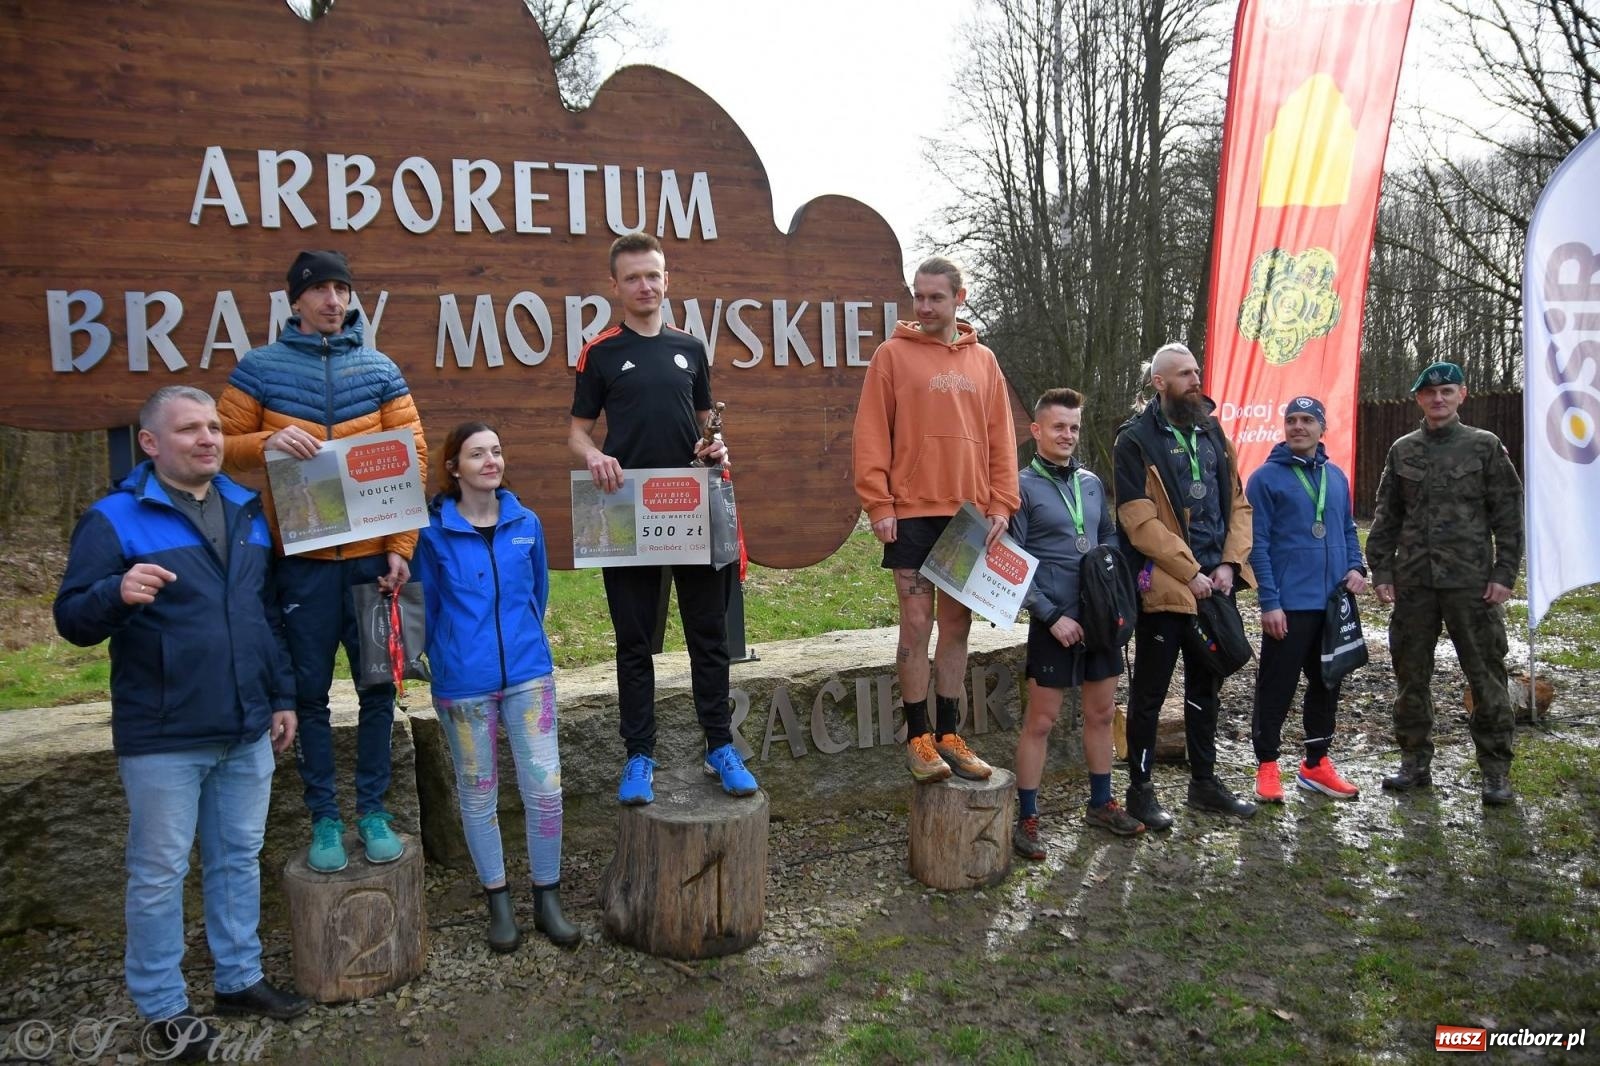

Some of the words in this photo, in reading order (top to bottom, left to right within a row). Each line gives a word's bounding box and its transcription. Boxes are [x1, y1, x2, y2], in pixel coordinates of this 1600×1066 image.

[189, 145, 718, 240] ARBORETUM
[1221, 399, 1273, 423] Dodaj
[349, 461, 407, 475] TWARDZIELA
[359, 481, 412, 497] VOUCHER
[362, 512, 398, 524] Racibórz
[642, 525, 676, 537] 500
[686, 525, 703, 536] zł
[648, 543, 682, 551] Racibórz
[982, 572, 1017, 598] VOUCHER
